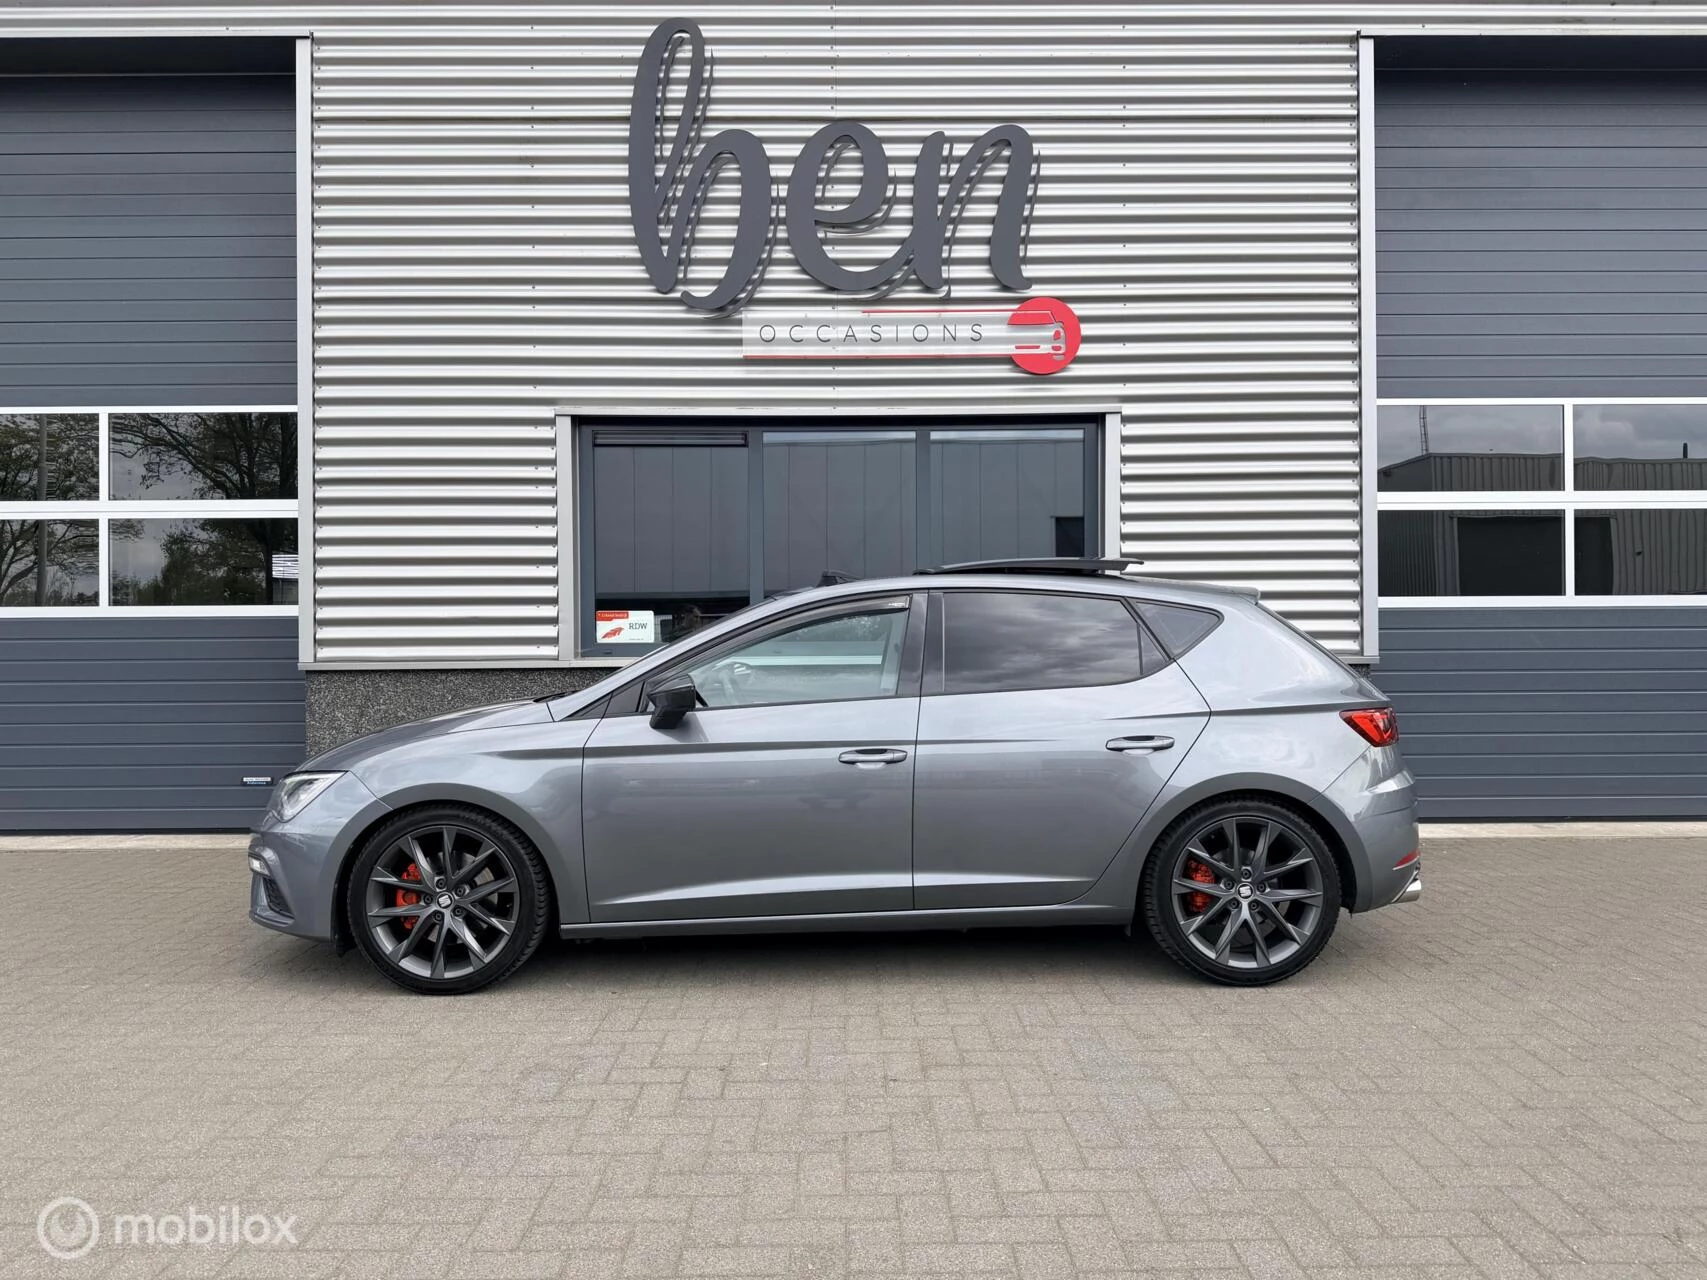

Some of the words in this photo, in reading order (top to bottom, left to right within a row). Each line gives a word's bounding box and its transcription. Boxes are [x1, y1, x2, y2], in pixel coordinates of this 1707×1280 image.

[628, 17, 1034, 310] ben
[758, 323, 983, 343] OCCASIONS
[628, 622, 648, 630] RDW
